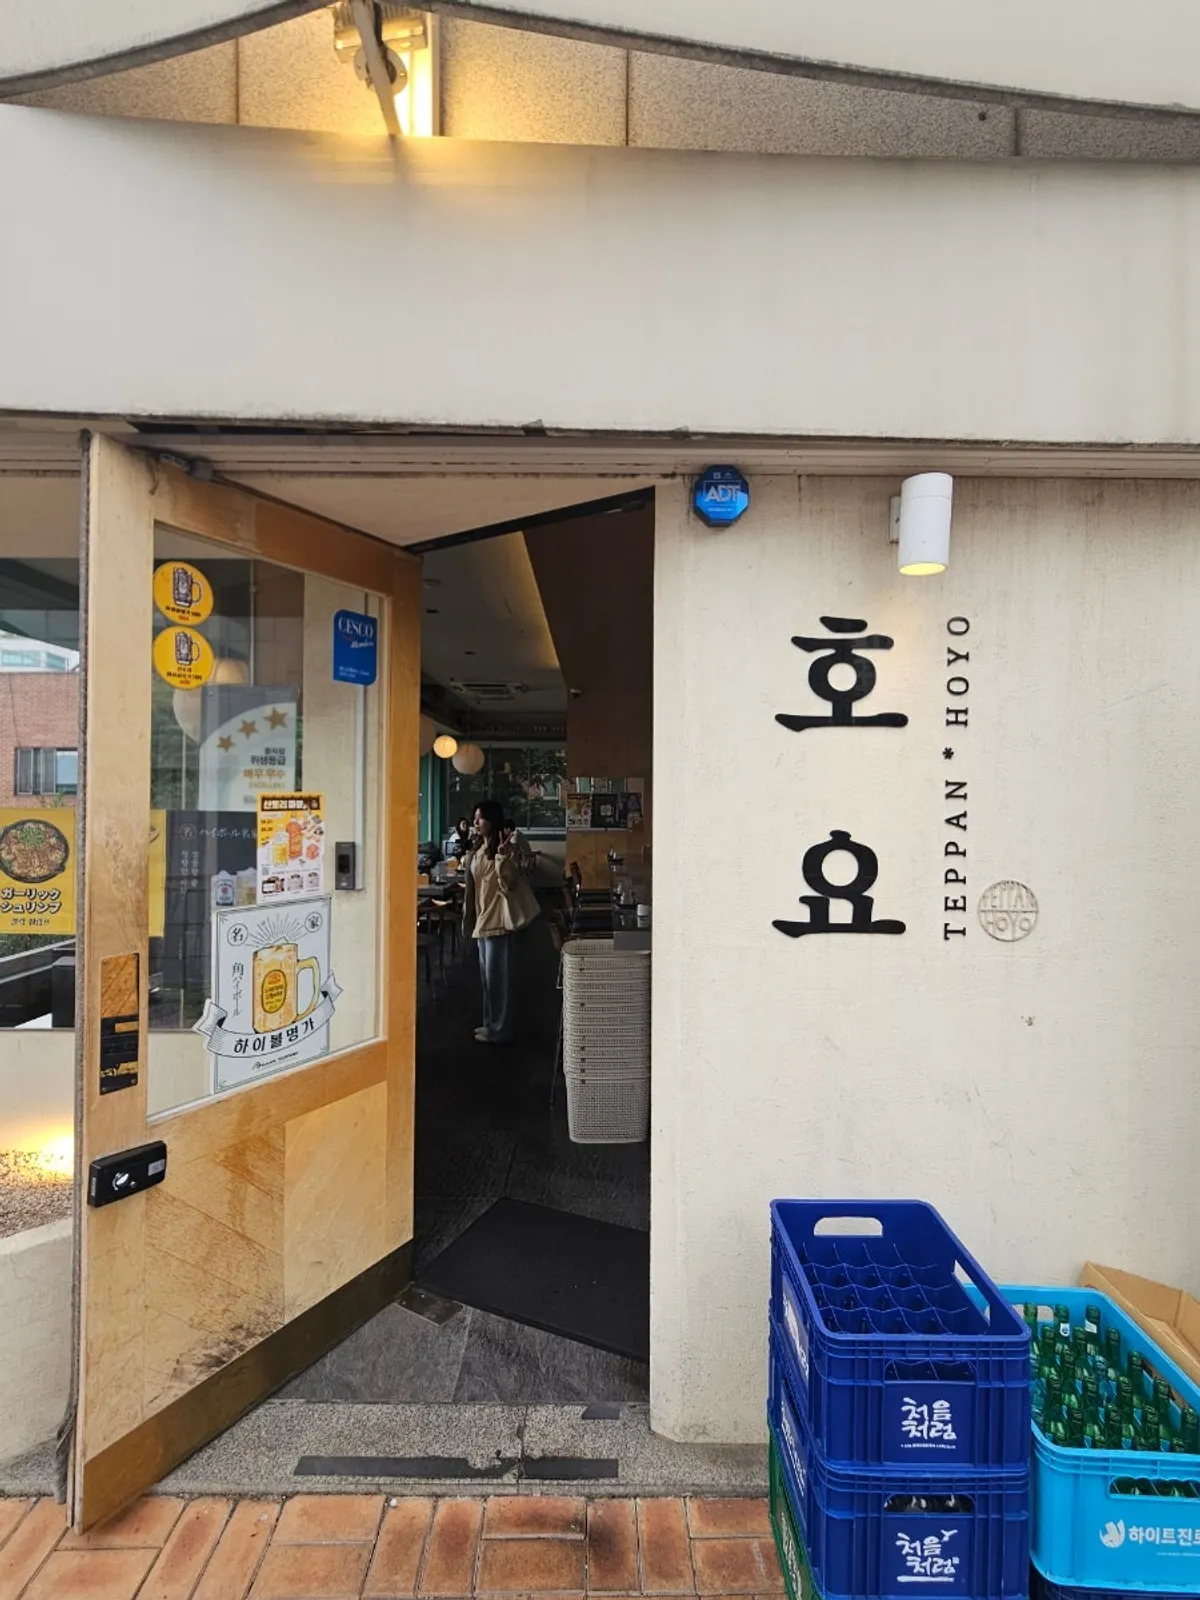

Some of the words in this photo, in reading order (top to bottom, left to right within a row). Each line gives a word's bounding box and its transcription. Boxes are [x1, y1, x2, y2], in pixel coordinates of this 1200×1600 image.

[703, 484, 741, 502] ADT
[338, 617, 373, 639] CESCO
[946, 616, 970, 728] HOYO
[944, 780, 968, 940] TEPPAN
[1, 886, 61, 900] ガーリック
[231, 962, 245, 1017] 角ハイボール
[233, 1017, 315, 1054] 하이볼명가
[901, 1397, 952, 1420] 처음
[901, 1420, 957, 1440] 처럼
[895, 1532, 942, 1556] 처음
[906, 1556, 956, 1576] 처럼
